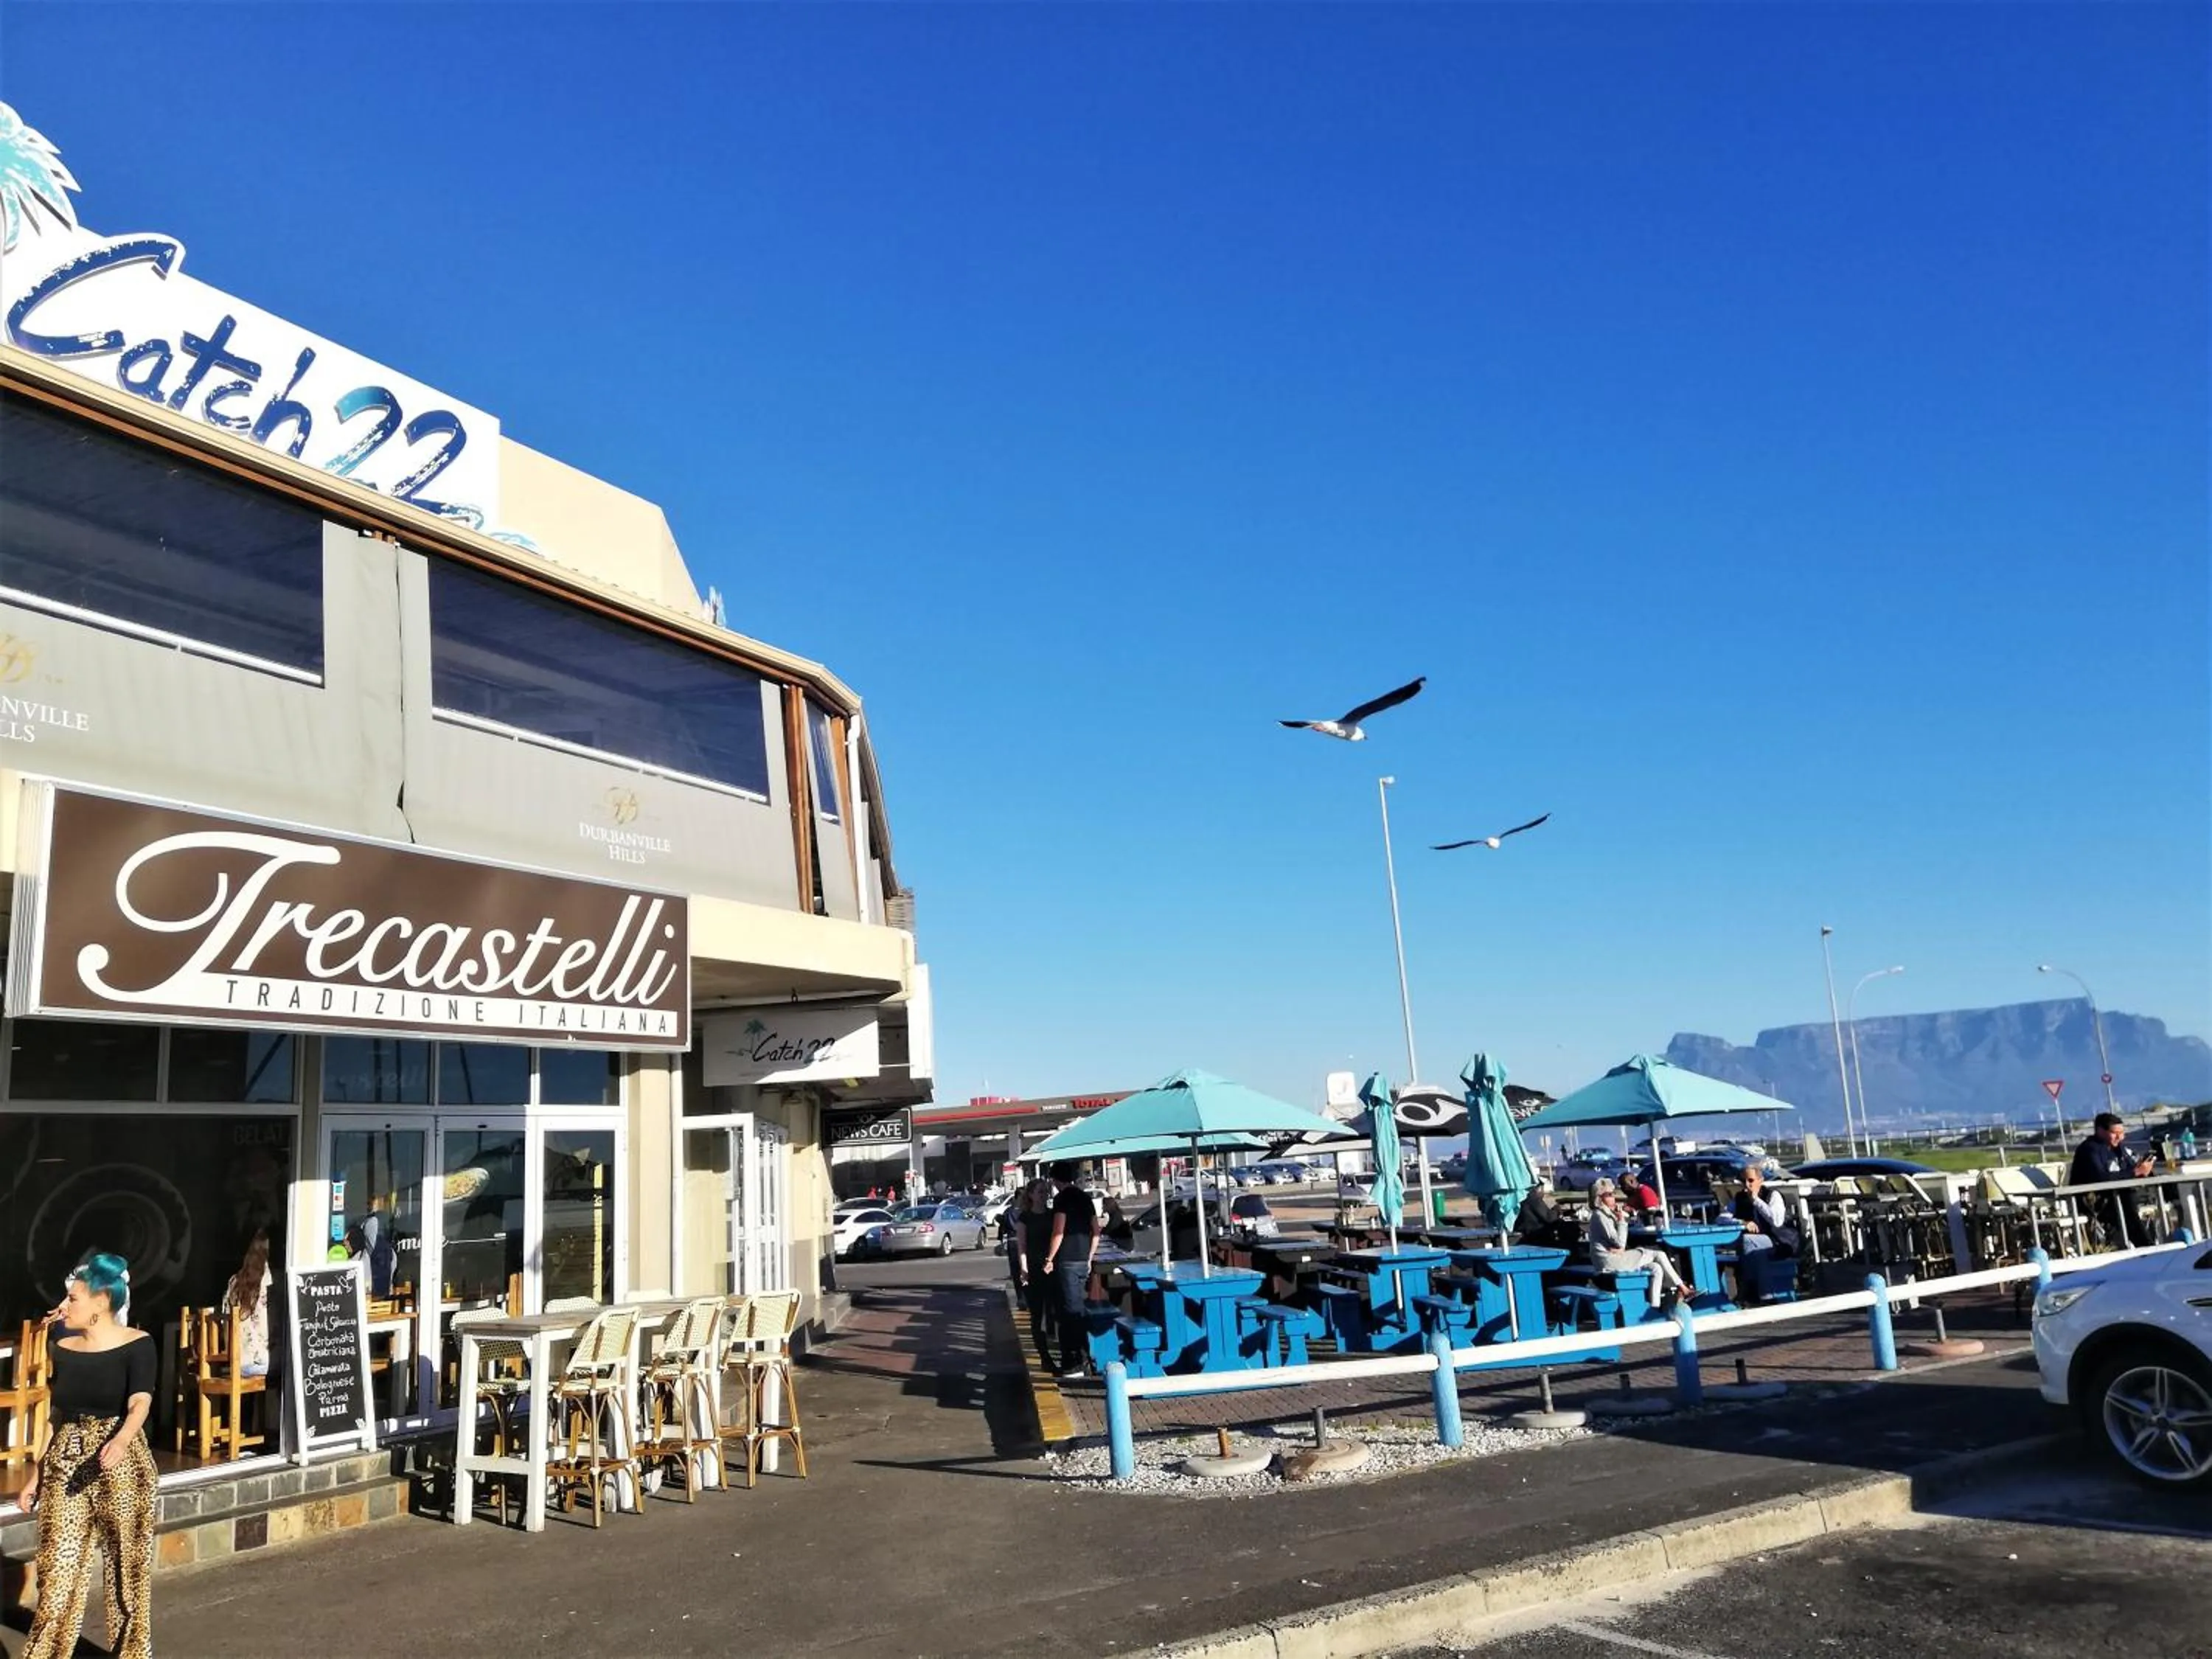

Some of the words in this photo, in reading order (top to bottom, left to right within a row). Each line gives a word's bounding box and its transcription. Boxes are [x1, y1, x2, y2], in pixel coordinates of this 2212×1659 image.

[6, 239, 316, 458] Catch
[579, 822, 671, 852] DURBANVILLE
[608, 844, 646, 863] HILLS
[77, 831, 677, 1006] Trecastelli
[227, 980, 485, 1023] TRADIZIONE
[518, 1004, 669, 1034] ITALIANA
[752, 1032, 803, 1062] Catch
[832, 1124, 868, 1138] NEWS
[310, 1285, 342, 1296] PASTA
[319, 1403, 348, 1418] PIZZA
